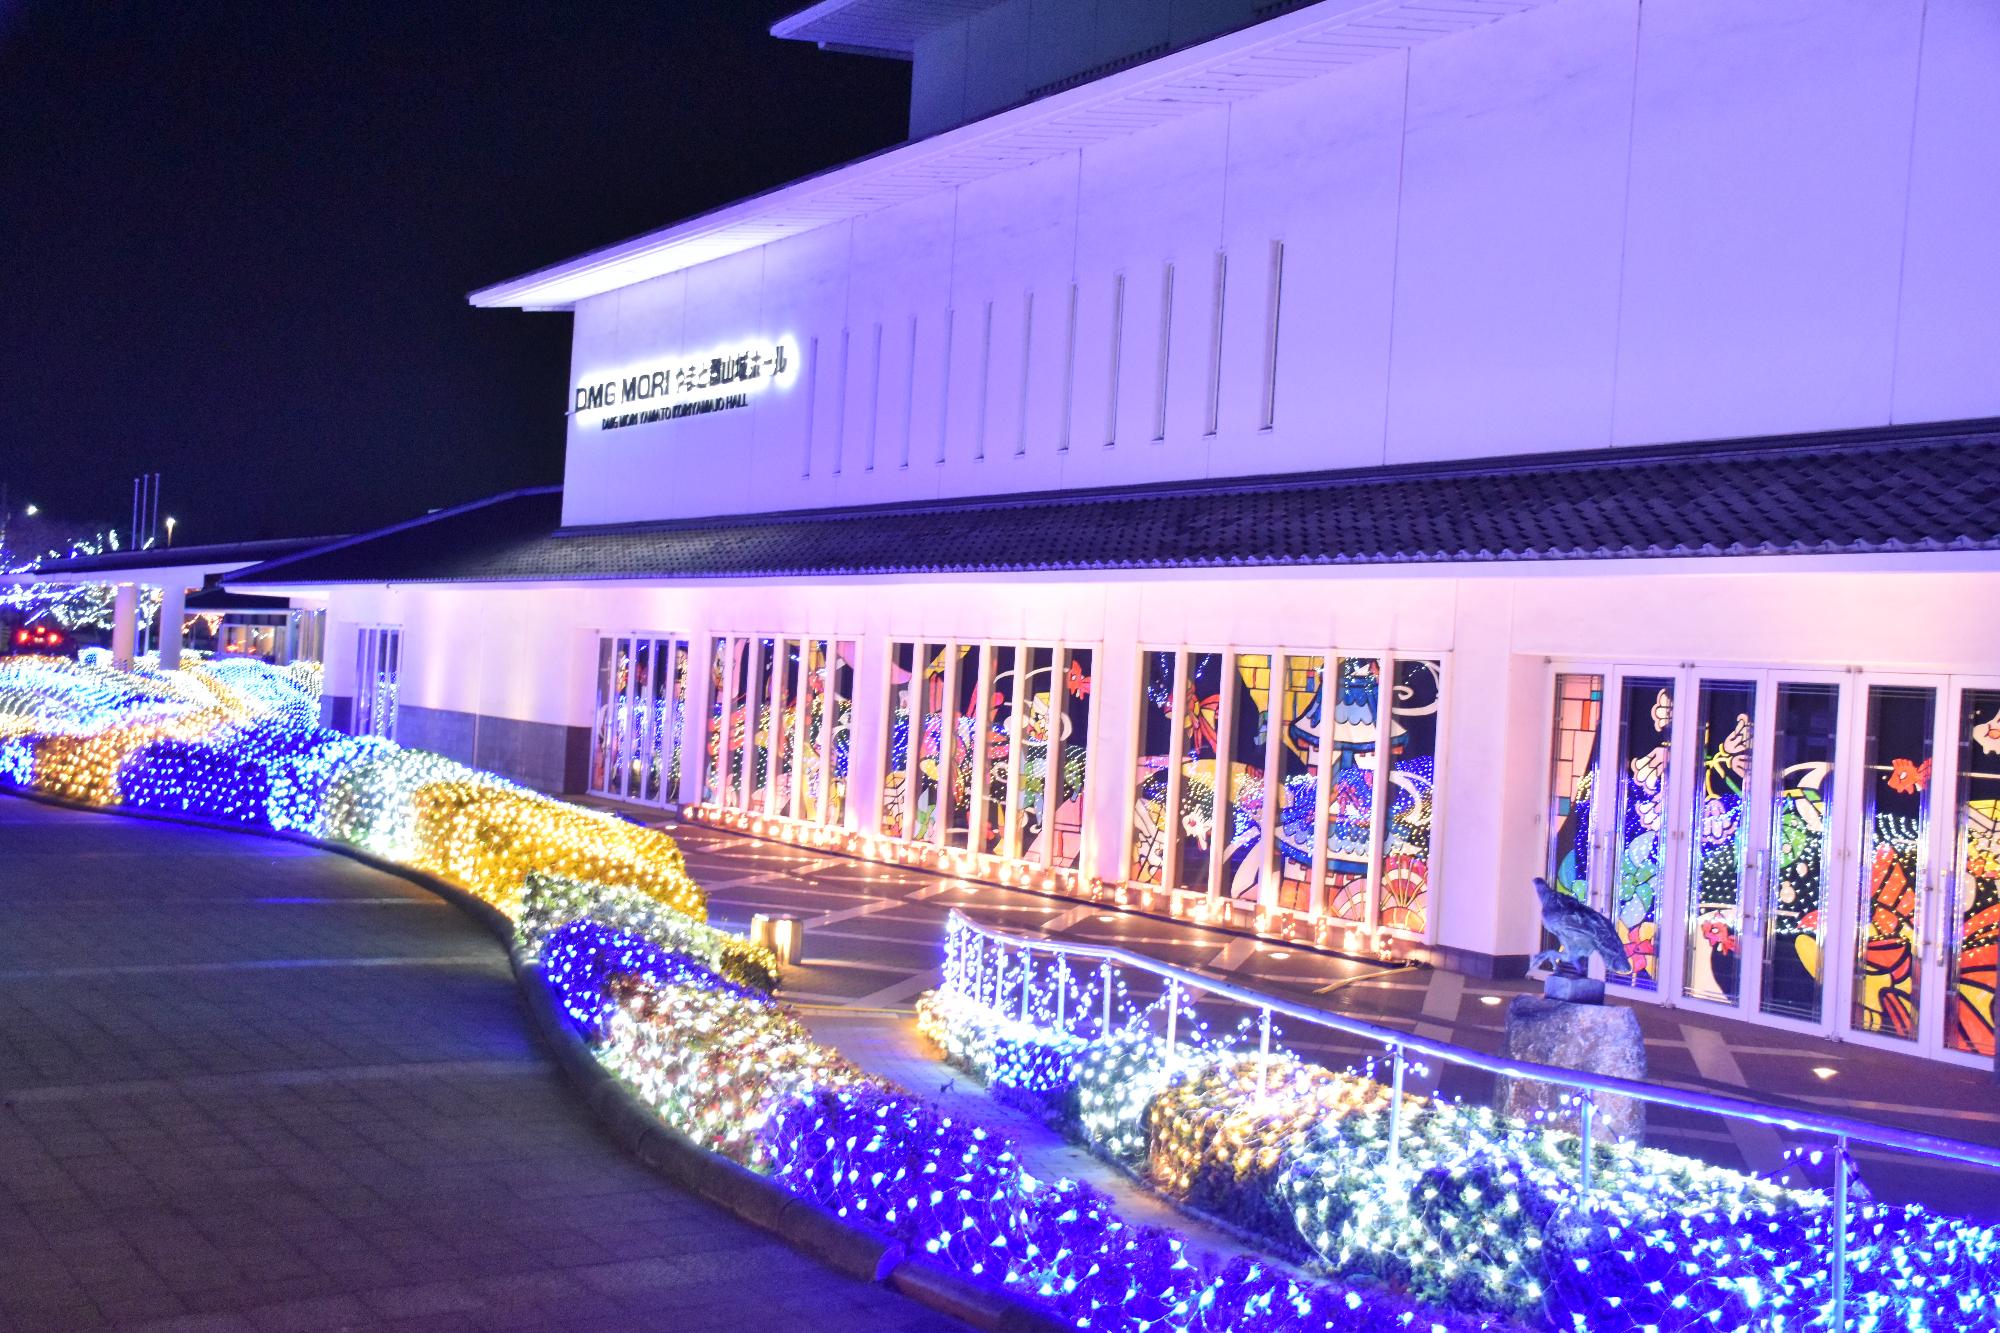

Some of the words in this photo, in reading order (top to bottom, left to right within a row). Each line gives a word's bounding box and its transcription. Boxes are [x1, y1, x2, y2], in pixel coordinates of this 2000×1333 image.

[575, 381, 616, 413] DMG
[621, 370, 670, 404] MORI
[602, 416, 618, 430] DMG
[640, 406, 671, 424] YAMATO
[725, 393, 748, 410] HALL
